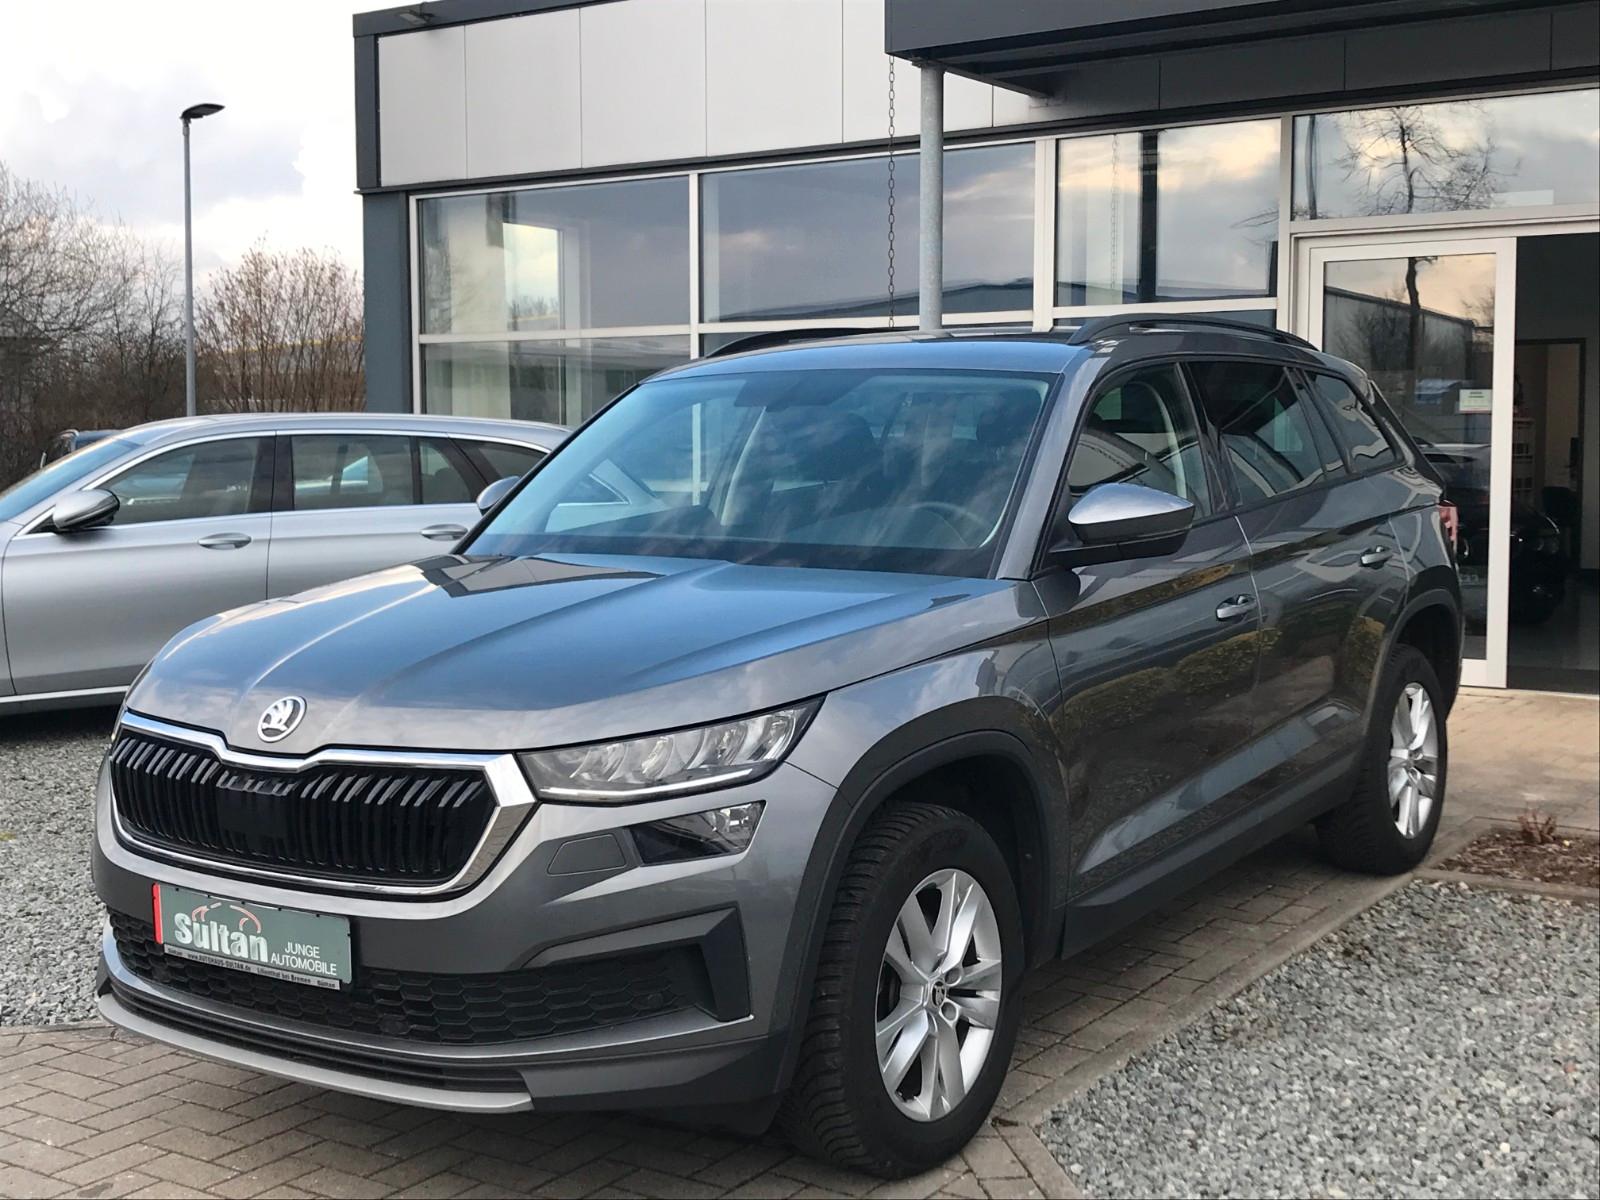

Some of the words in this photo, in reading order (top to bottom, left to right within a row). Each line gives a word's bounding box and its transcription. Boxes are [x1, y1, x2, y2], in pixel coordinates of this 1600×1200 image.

[174, 912, 268, 963] Sultan
[284, 942, 320, 959] JUNGE
[270, 952, 337, 976] AUTOMOBILE
